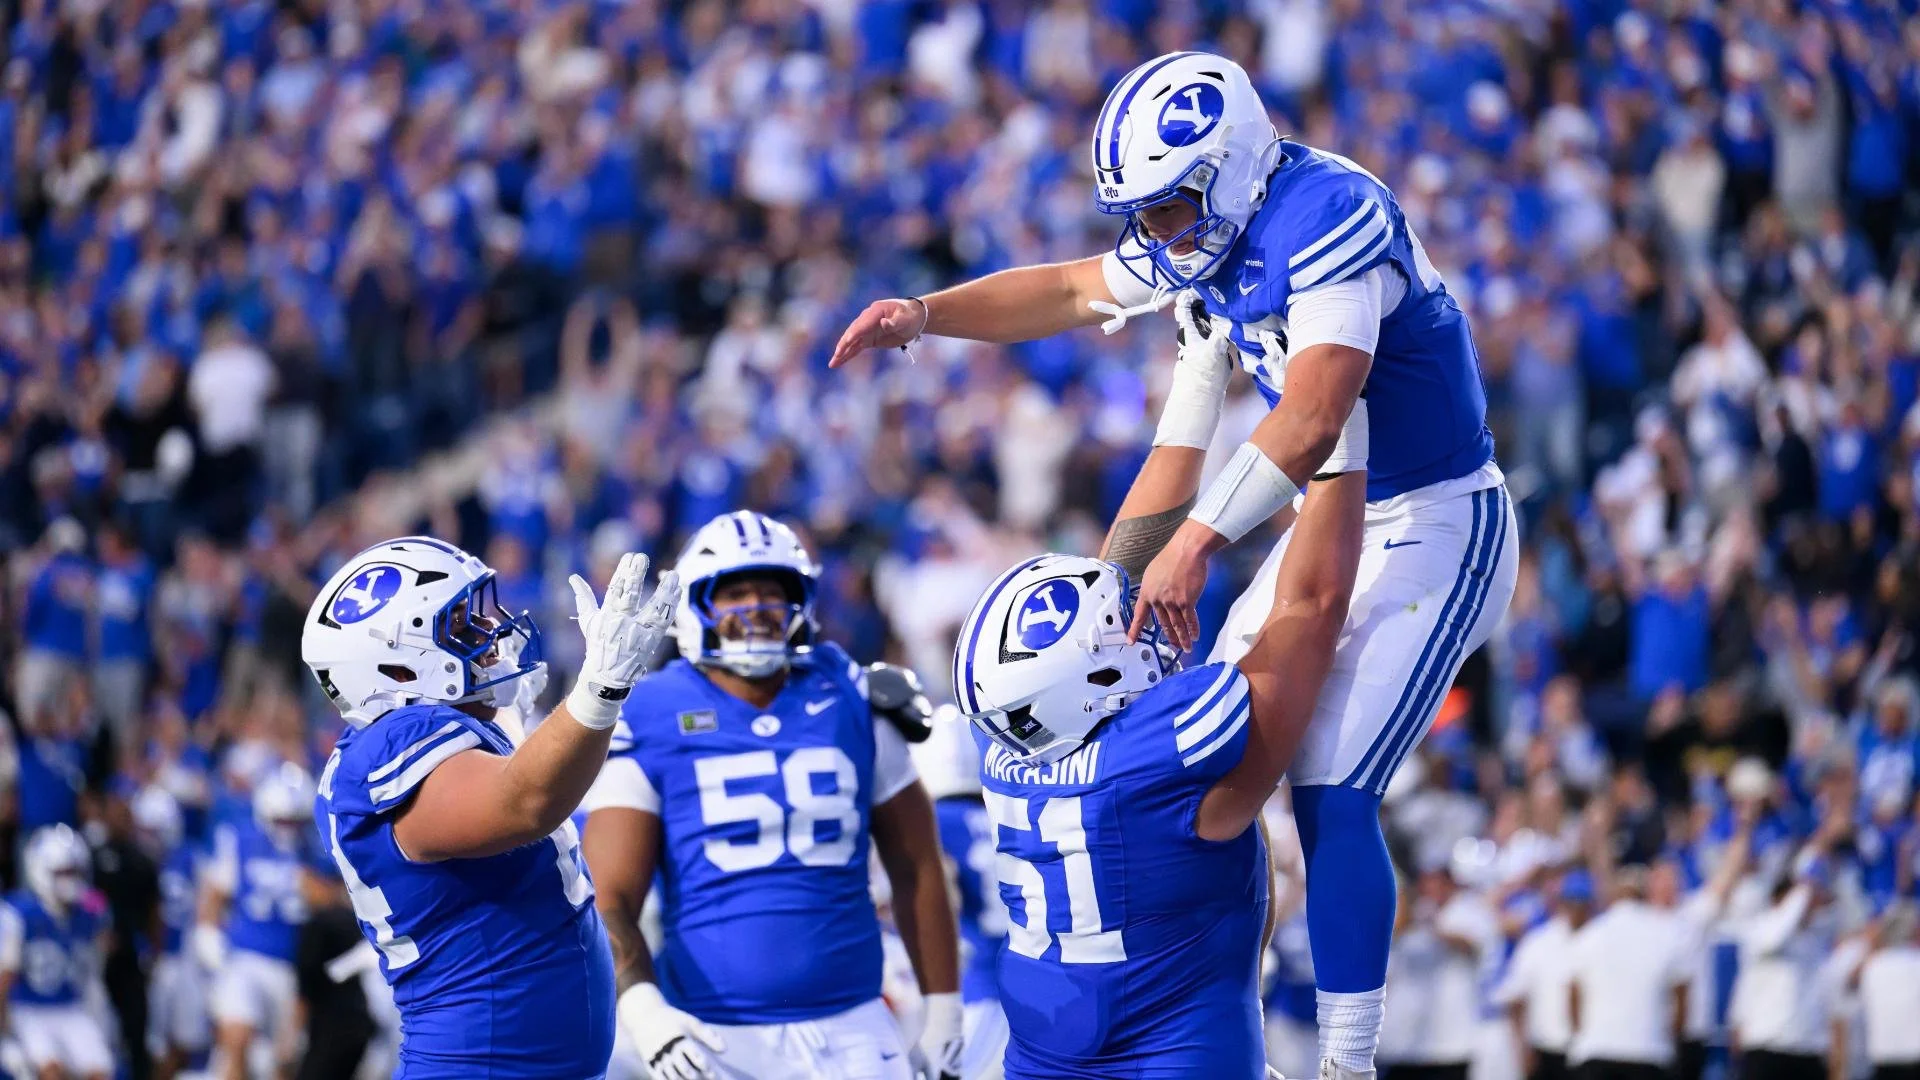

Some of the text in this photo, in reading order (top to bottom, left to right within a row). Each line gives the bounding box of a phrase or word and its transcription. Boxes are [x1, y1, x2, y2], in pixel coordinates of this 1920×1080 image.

[1161, 86, 1214, 135] Y
[337, 569, 382, 616] Y
[1020, 584, 1072, 633] Y
[695, 747, 861, 873] 58
[982, 786, 1128, 965] 51
